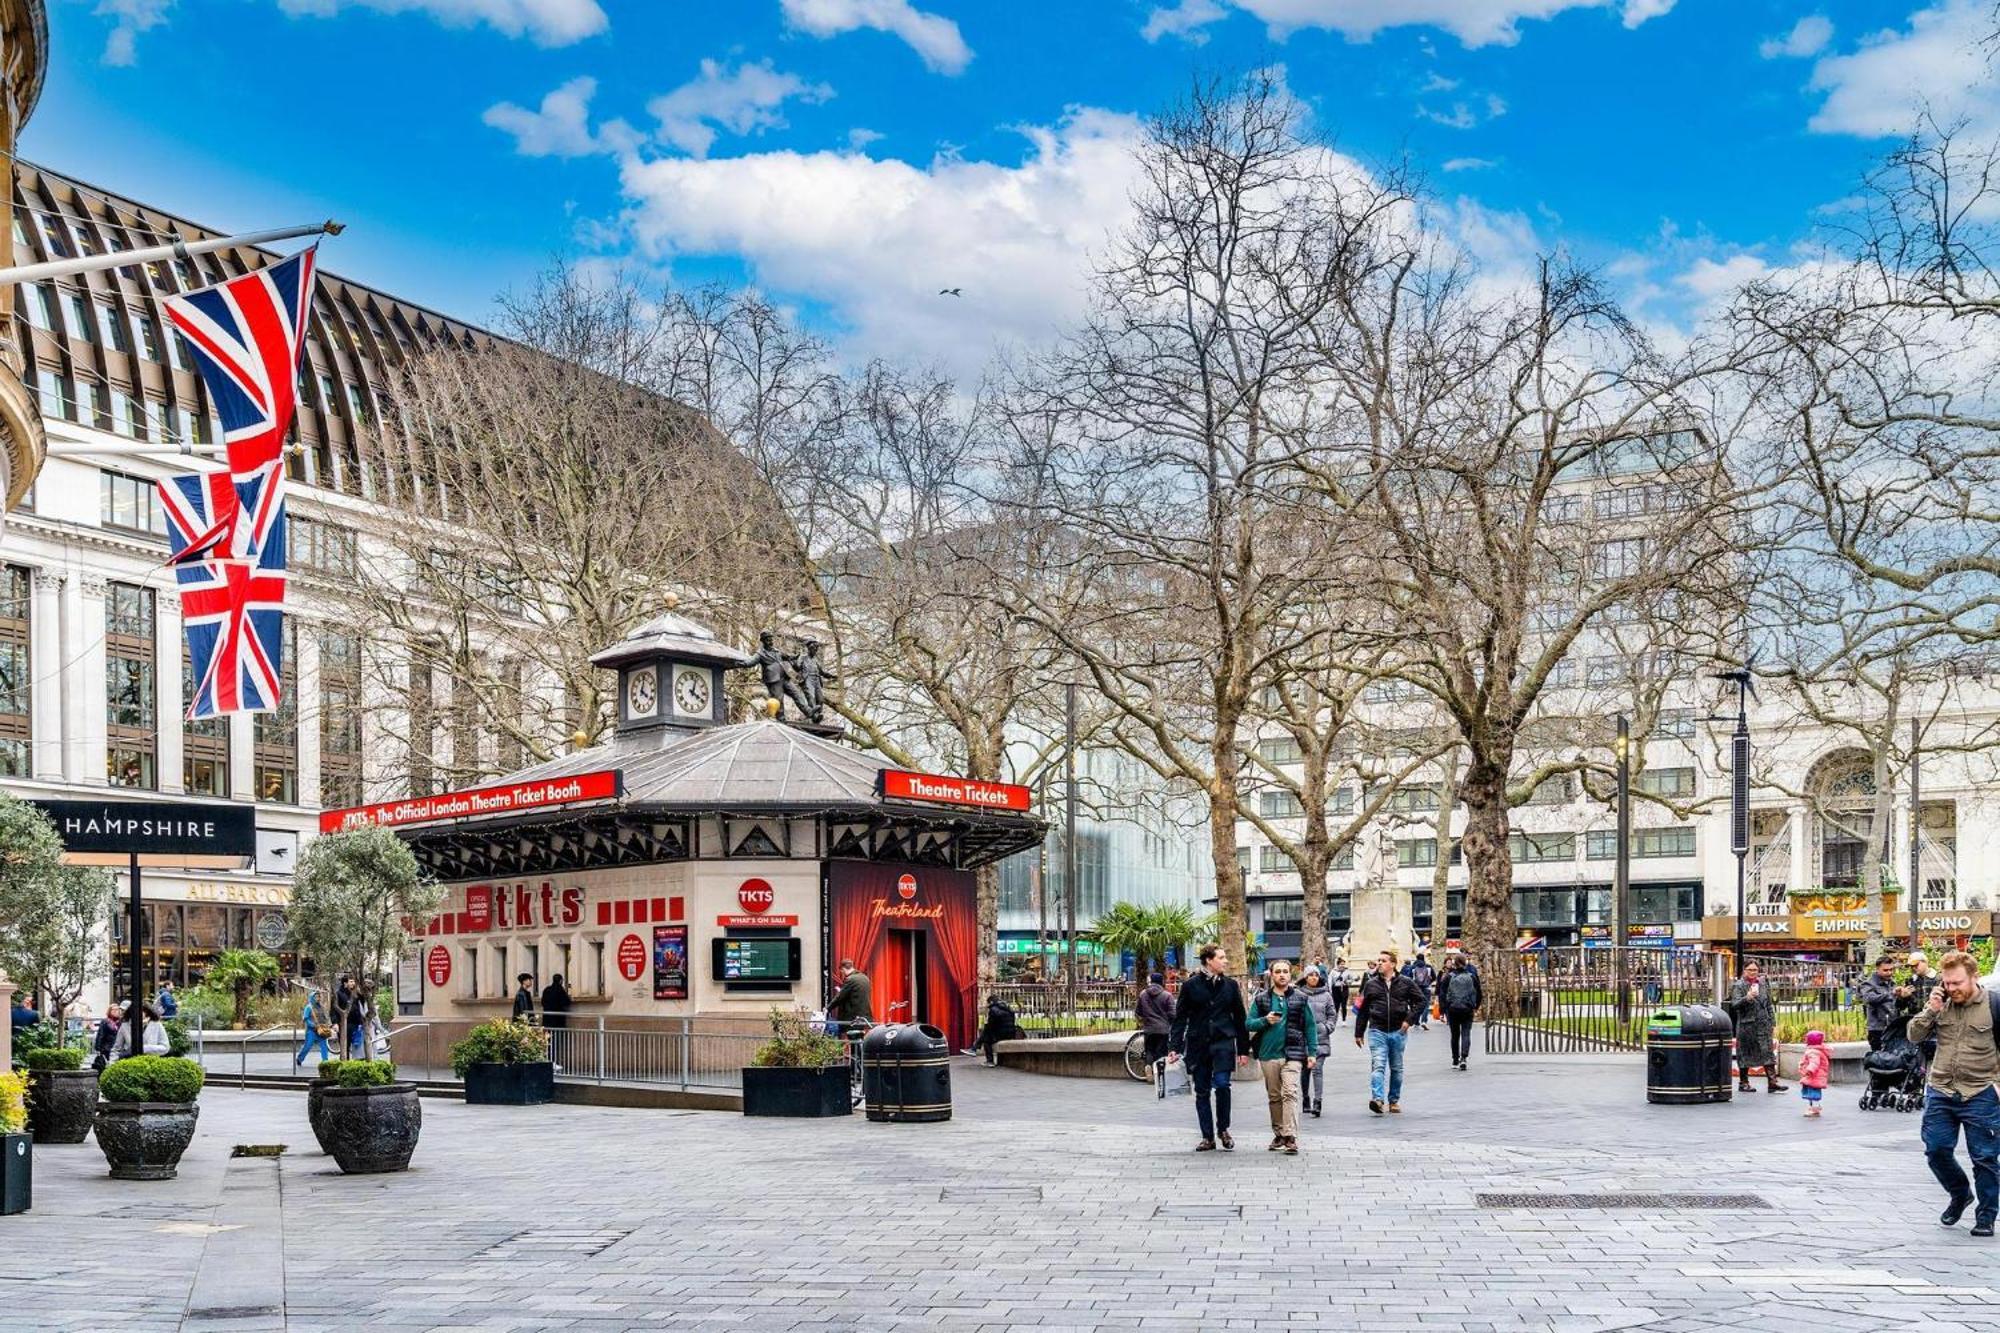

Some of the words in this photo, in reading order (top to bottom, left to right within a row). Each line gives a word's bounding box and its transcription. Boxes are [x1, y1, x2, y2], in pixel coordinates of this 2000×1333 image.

[909, 778, 961, 799] Theatre
[964, 785, 1008, 804] Tickets
[345, 811, 368, 827] TKTS
[377, 808, 393, 823] The
[395, 801, 430, 820] Official
[431, 797, 469, 816] London
[471, 793, 511, 811] Theatre
[513, 786, 545, 805] Ticket
[547, 780, 581, 800] Booth
[65, 818, 215, 837] HAMPSHIRE
[186, 882, 218, 900] ALL
[225, 885, 258, 902] BAR
[266, 888, 291, 904] ON
[739, 891, 773, 902] TKTS
[495, 881, 583, 927] tkts
[872, 899, 943, 918] Theatreland
[1743, 921, 1790, 933] MAX
[1814, 919, 1868, 932] EMPIRE
